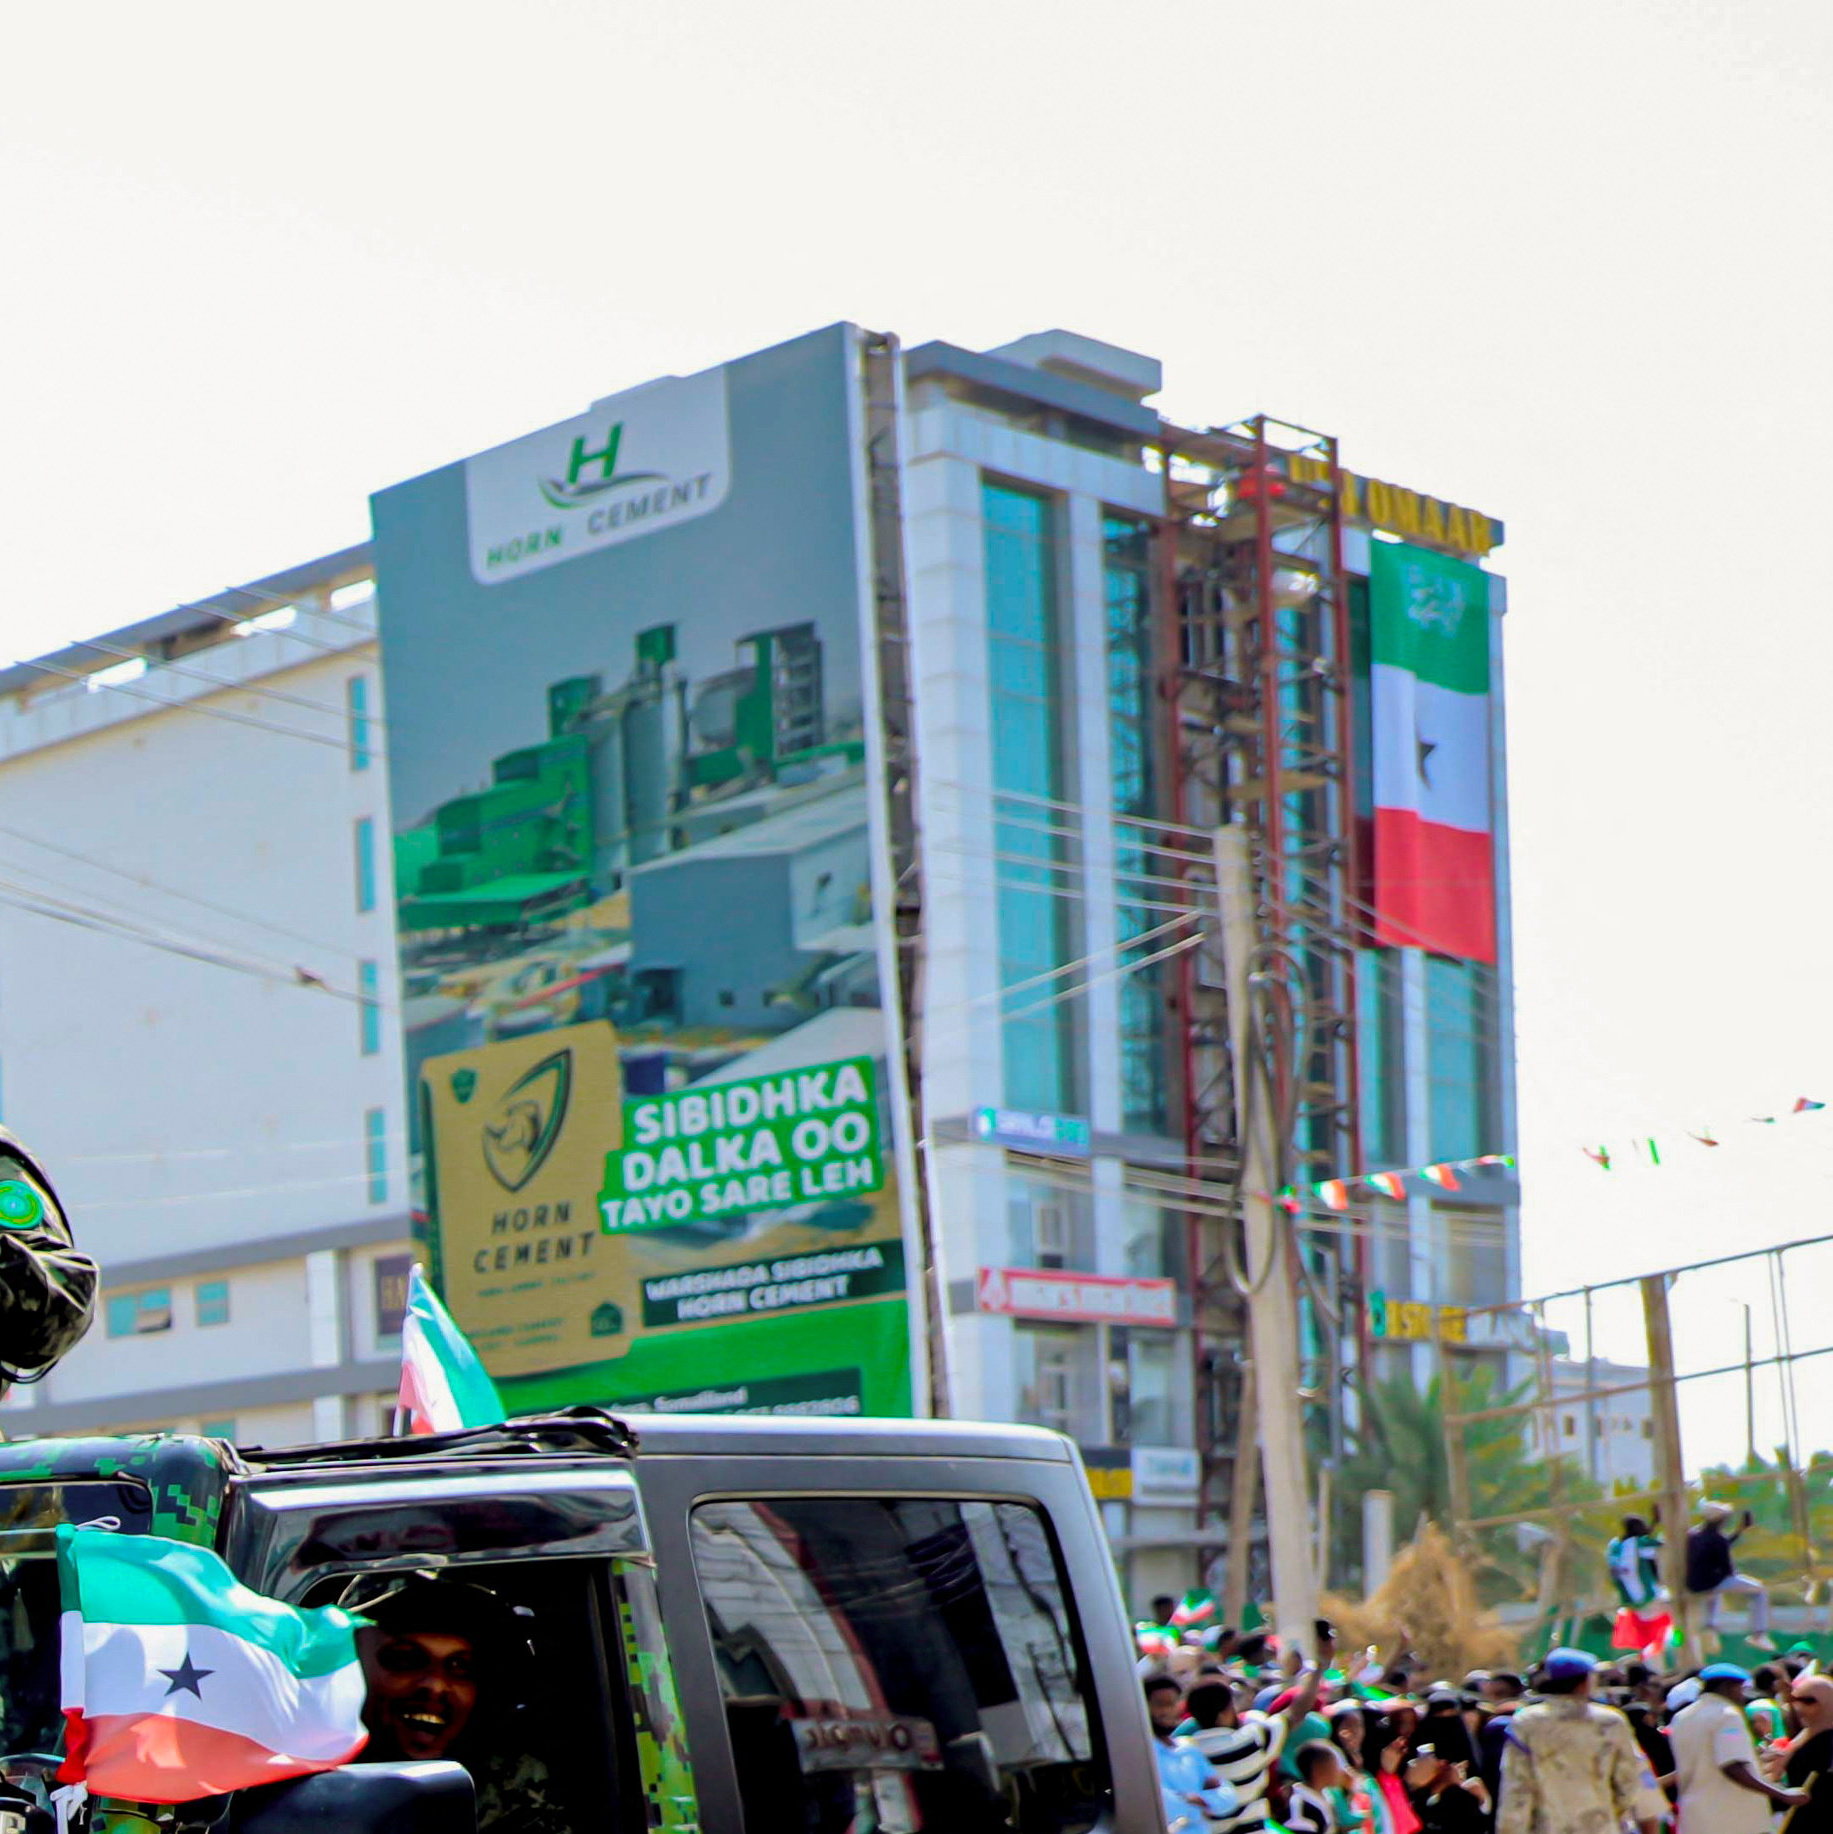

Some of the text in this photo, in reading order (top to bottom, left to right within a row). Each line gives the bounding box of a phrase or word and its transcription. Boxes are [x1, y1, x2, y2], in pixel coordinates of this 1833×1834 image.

[486, 472, 713, 570] HORN CEMENT
[633, 1064, 869, 1145] SIBIDHKA
[622, 1111, 871, 1193] DALKA OO
[492, 1200, 571, 1235] HORN
[600, 1156, 874, 1229] TAYO SARE LEH
[473, 1230, 595, 1274] CEMENT
[645, 1246, 884, 1302] WARSHADA SIBIDHKA
[677, 1273, 850, 1321] HORN CEMENT
